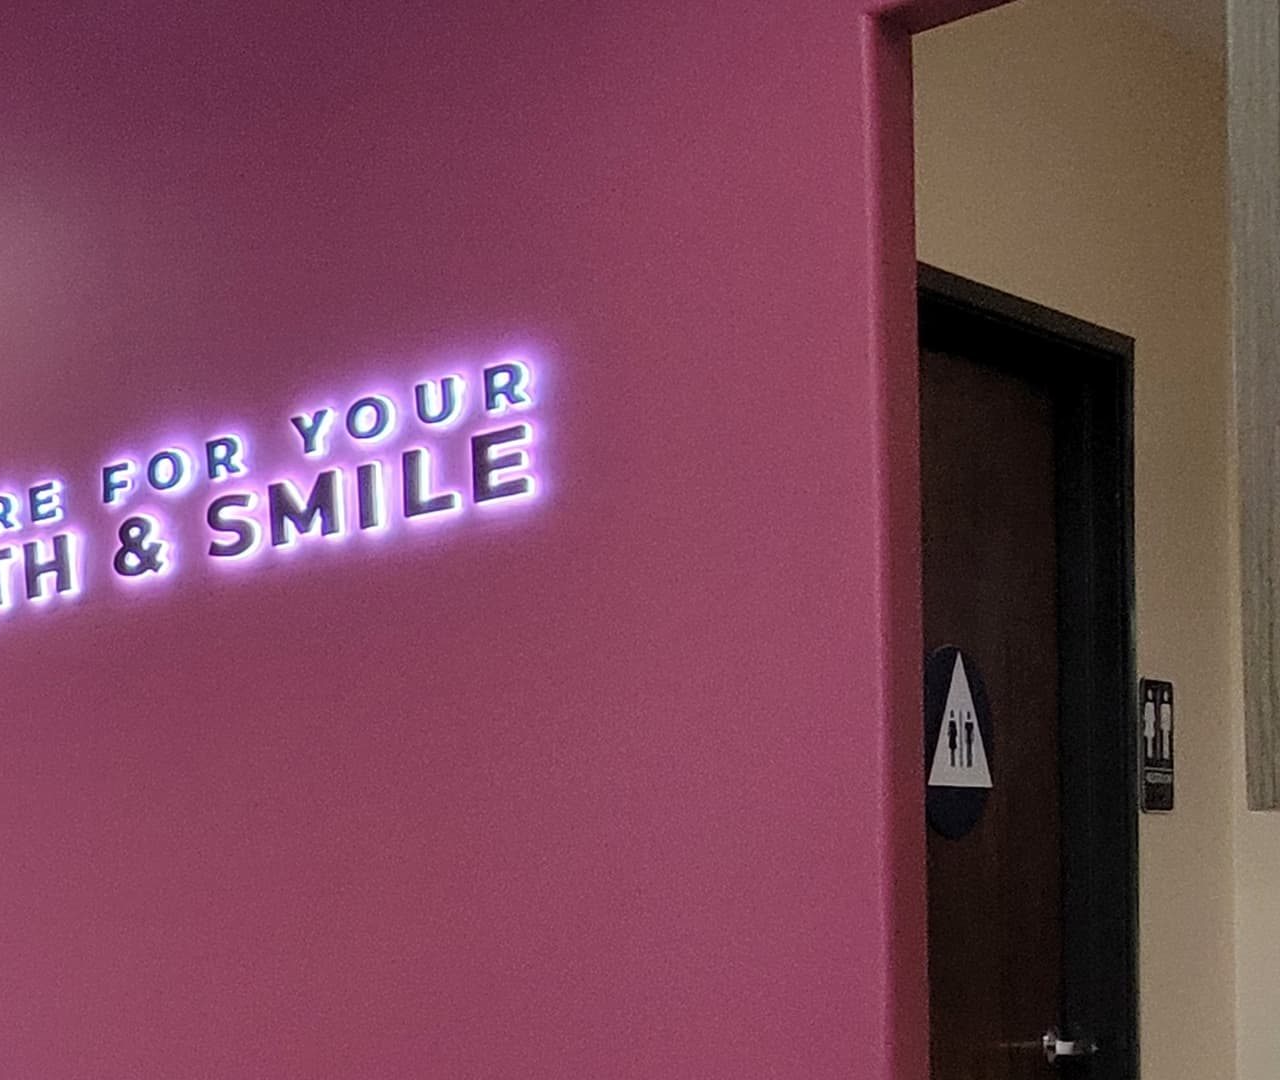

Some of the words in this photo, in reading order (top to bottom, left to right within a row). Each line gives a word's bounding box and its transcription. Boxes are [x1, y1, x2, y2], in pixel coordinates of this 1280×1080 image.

[102, 434, 243, 504] FOR
[290, 361, 532, 455] YOUR
[112, 514, 166, 578] &
[205, 424, 534, 558] SMILE
